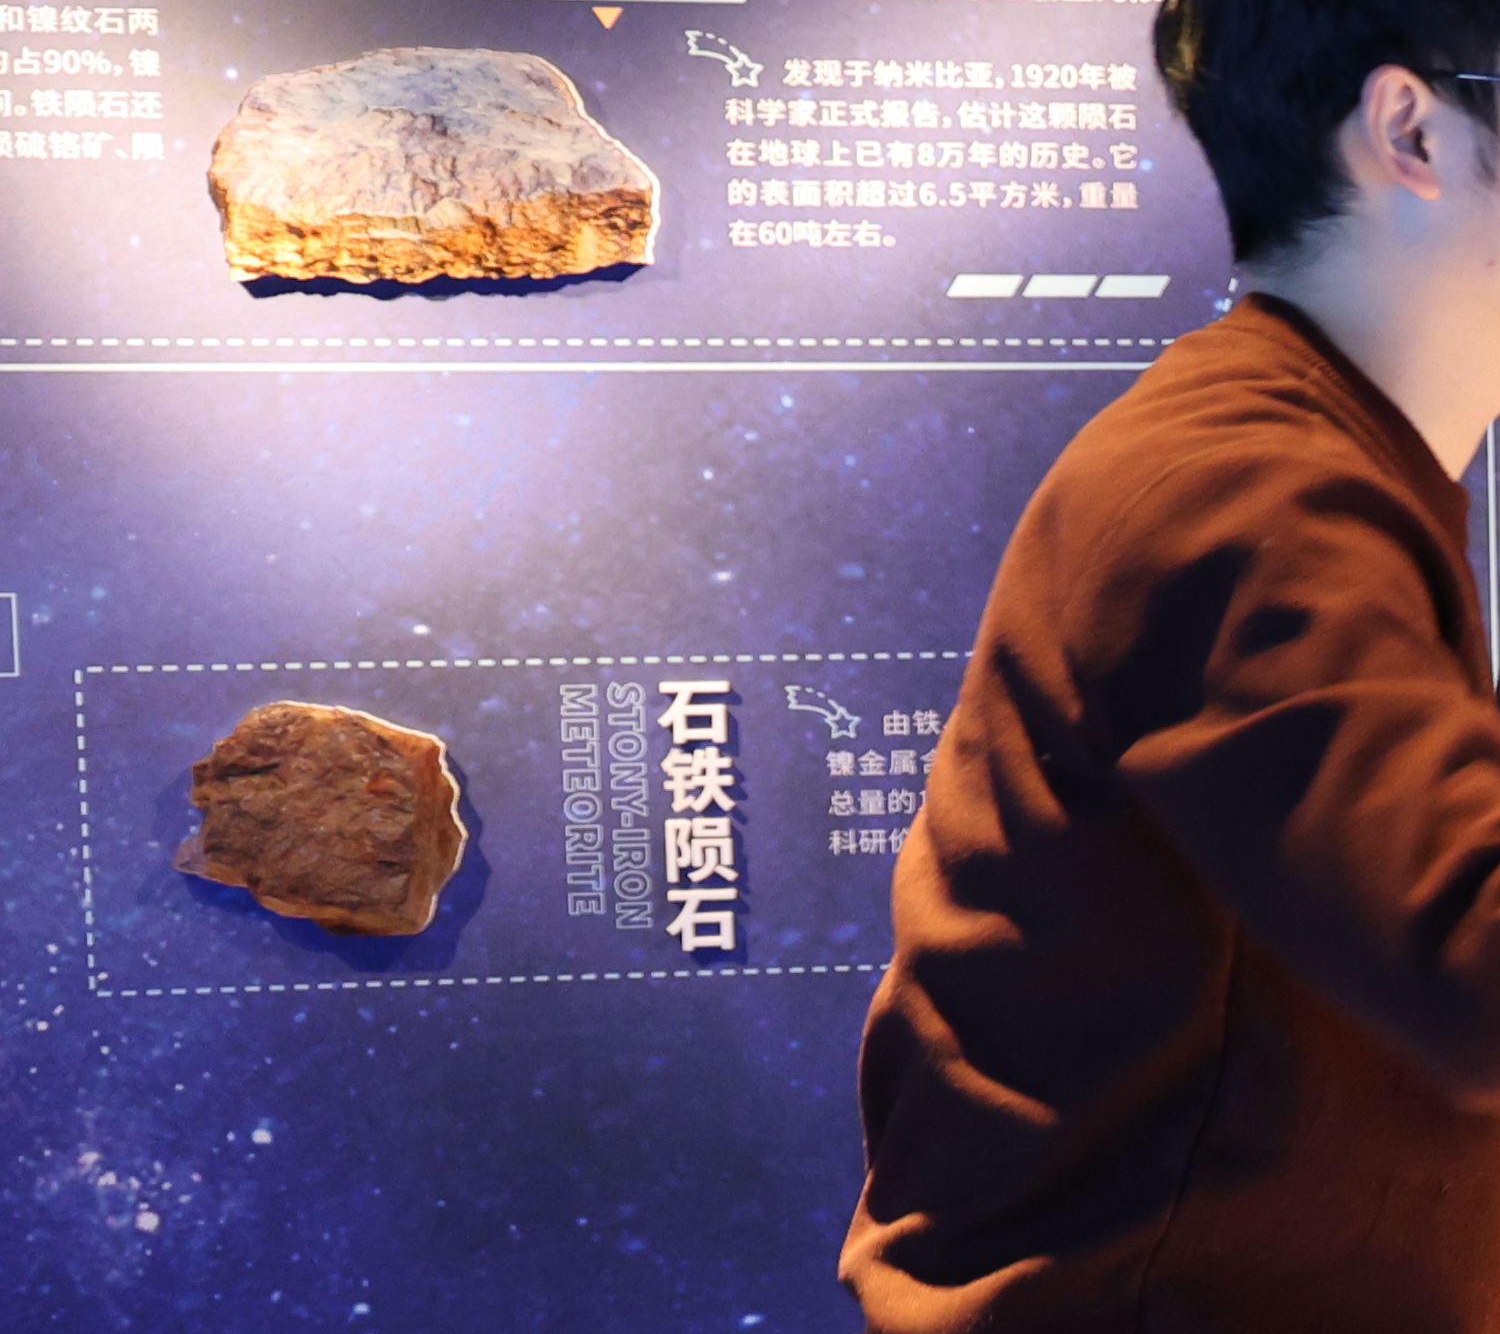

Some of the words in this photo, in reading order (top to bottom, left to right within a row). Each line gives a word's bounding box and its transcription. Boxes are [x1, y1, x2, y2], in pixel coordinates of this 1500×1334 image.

[0, 46, 162, 78] 占90%，镍
[727, 220, 897, 249] 在60吨左右。
[882, 709, 948, 737] 由铁
[559, 683, 607, 917] METEORITE
[606, 681, 654, 930] STONY-IRON
[656, 679, 740, 953] 石铁陨石
